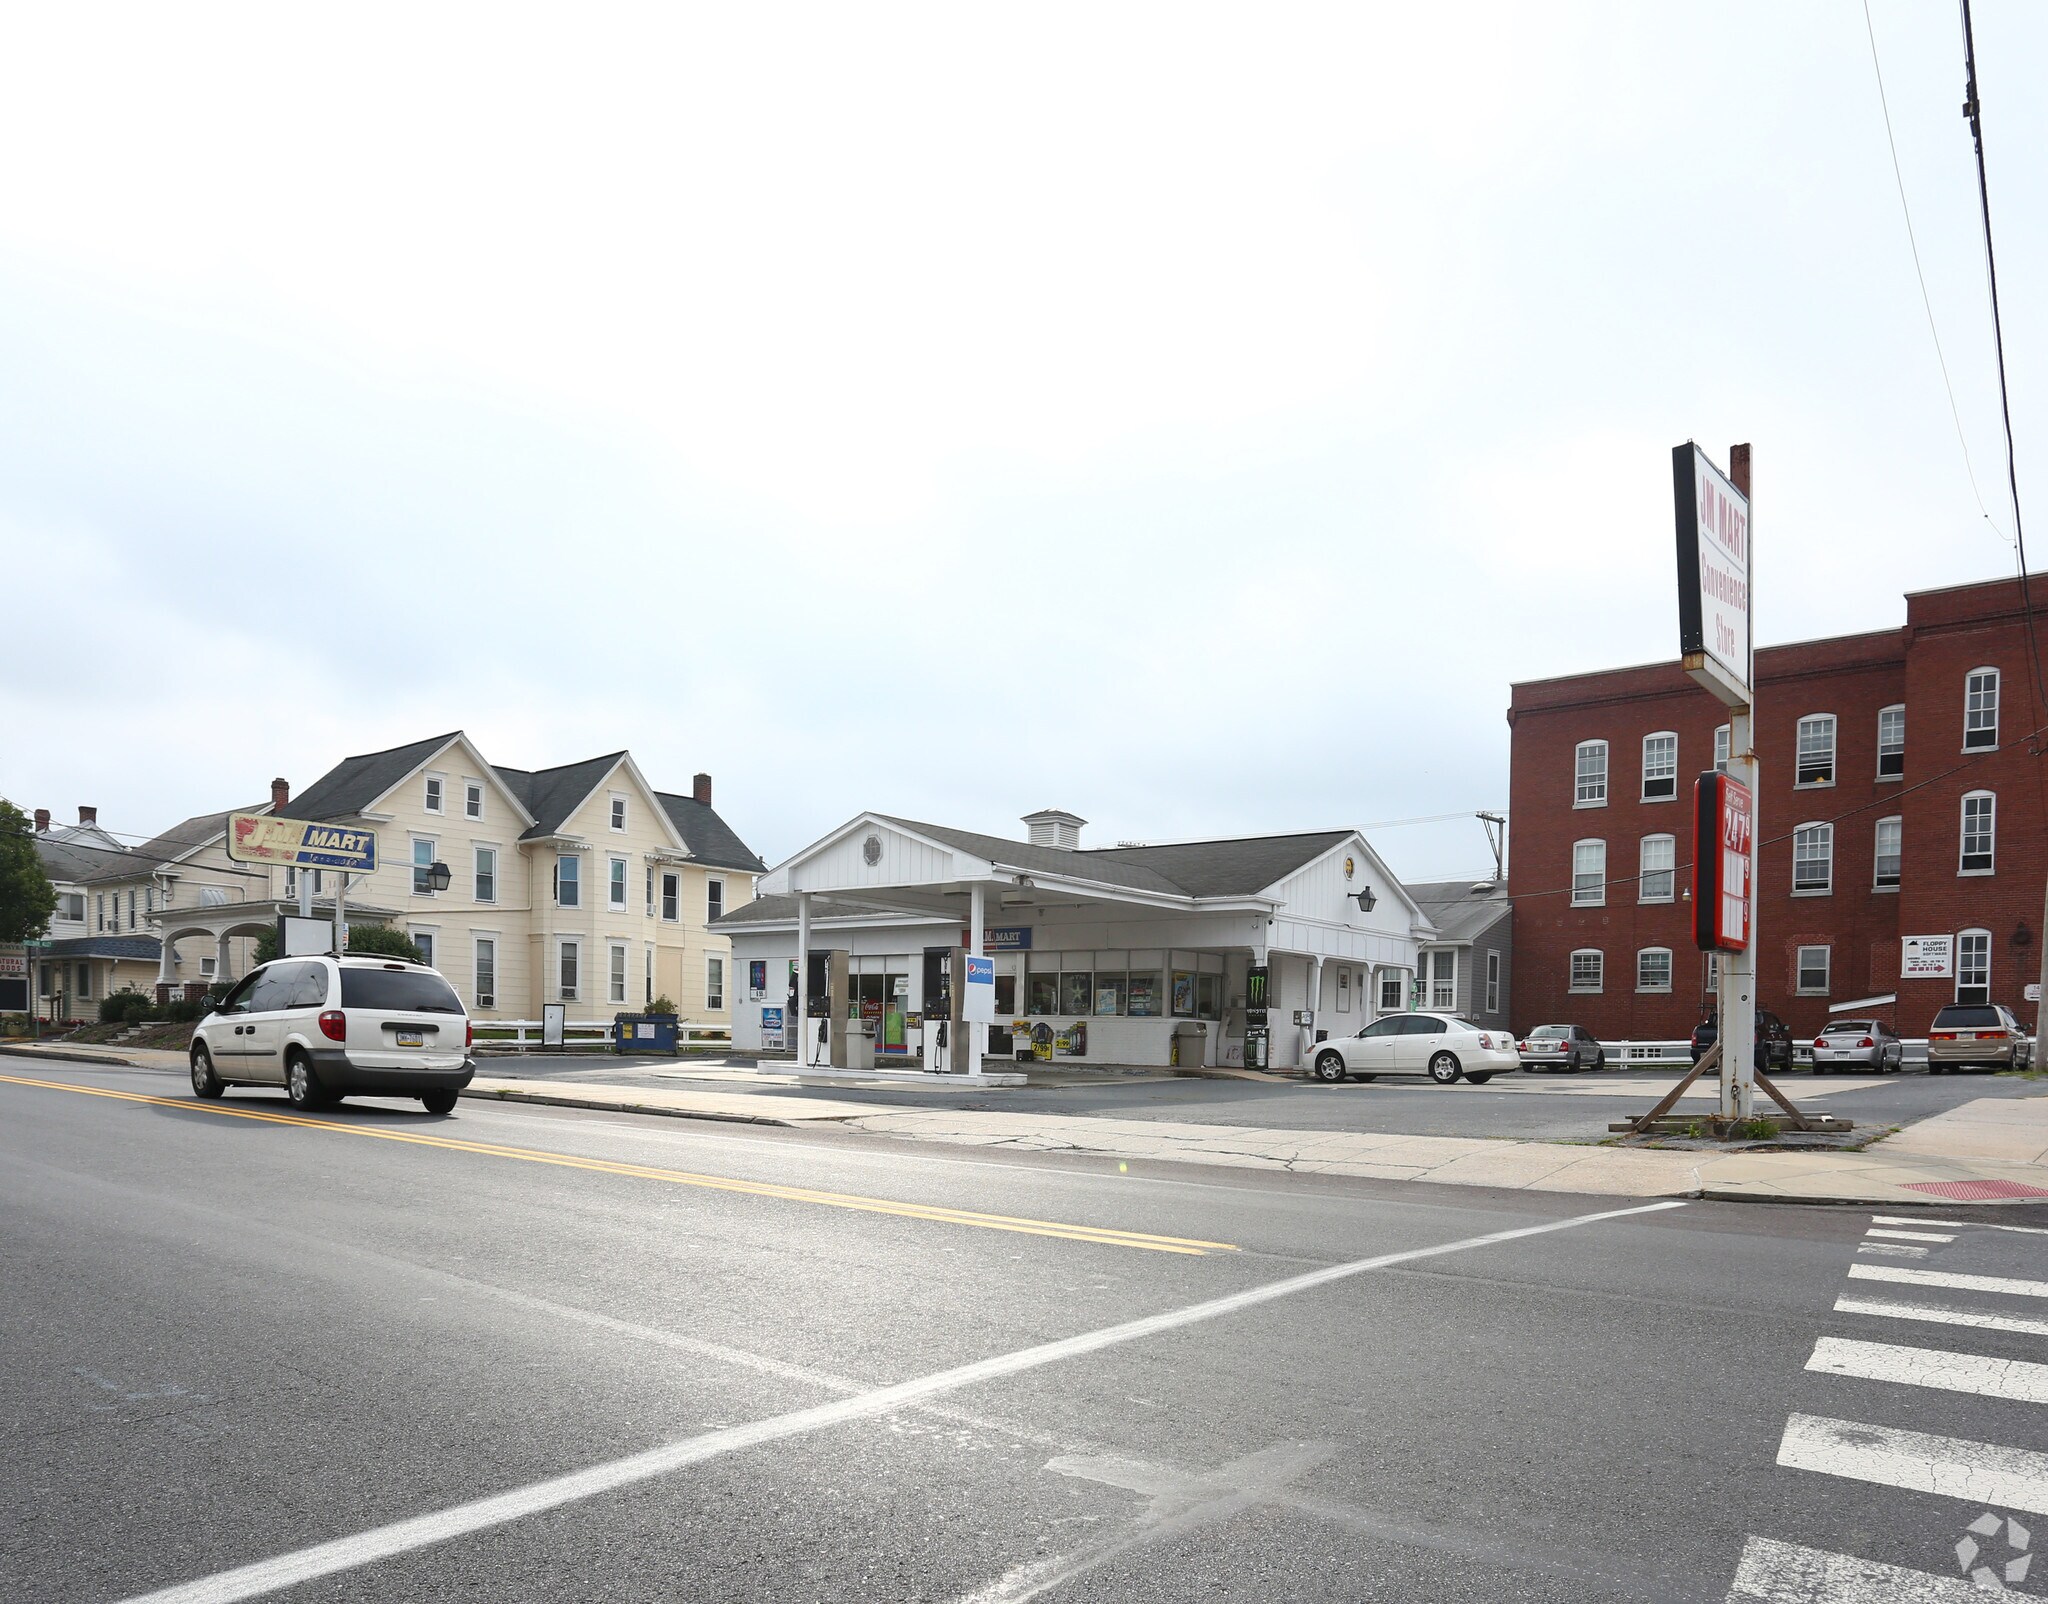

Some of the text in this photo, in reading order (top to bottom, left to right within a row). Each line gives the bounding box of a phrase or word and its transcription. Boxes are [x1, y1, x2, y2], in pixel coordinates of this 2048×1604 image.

[1700, 475, 1746, 562] JM MART
[1701, 552, 1746, 612] Convenience
[1715, 612, 1736, 658] Store
[1733, 792, 1744, 808] Serve
[307, 830, 370, 851] MART
[1725, 808, 1746, 852] 247
[995, 932, 1021, 942] MART
